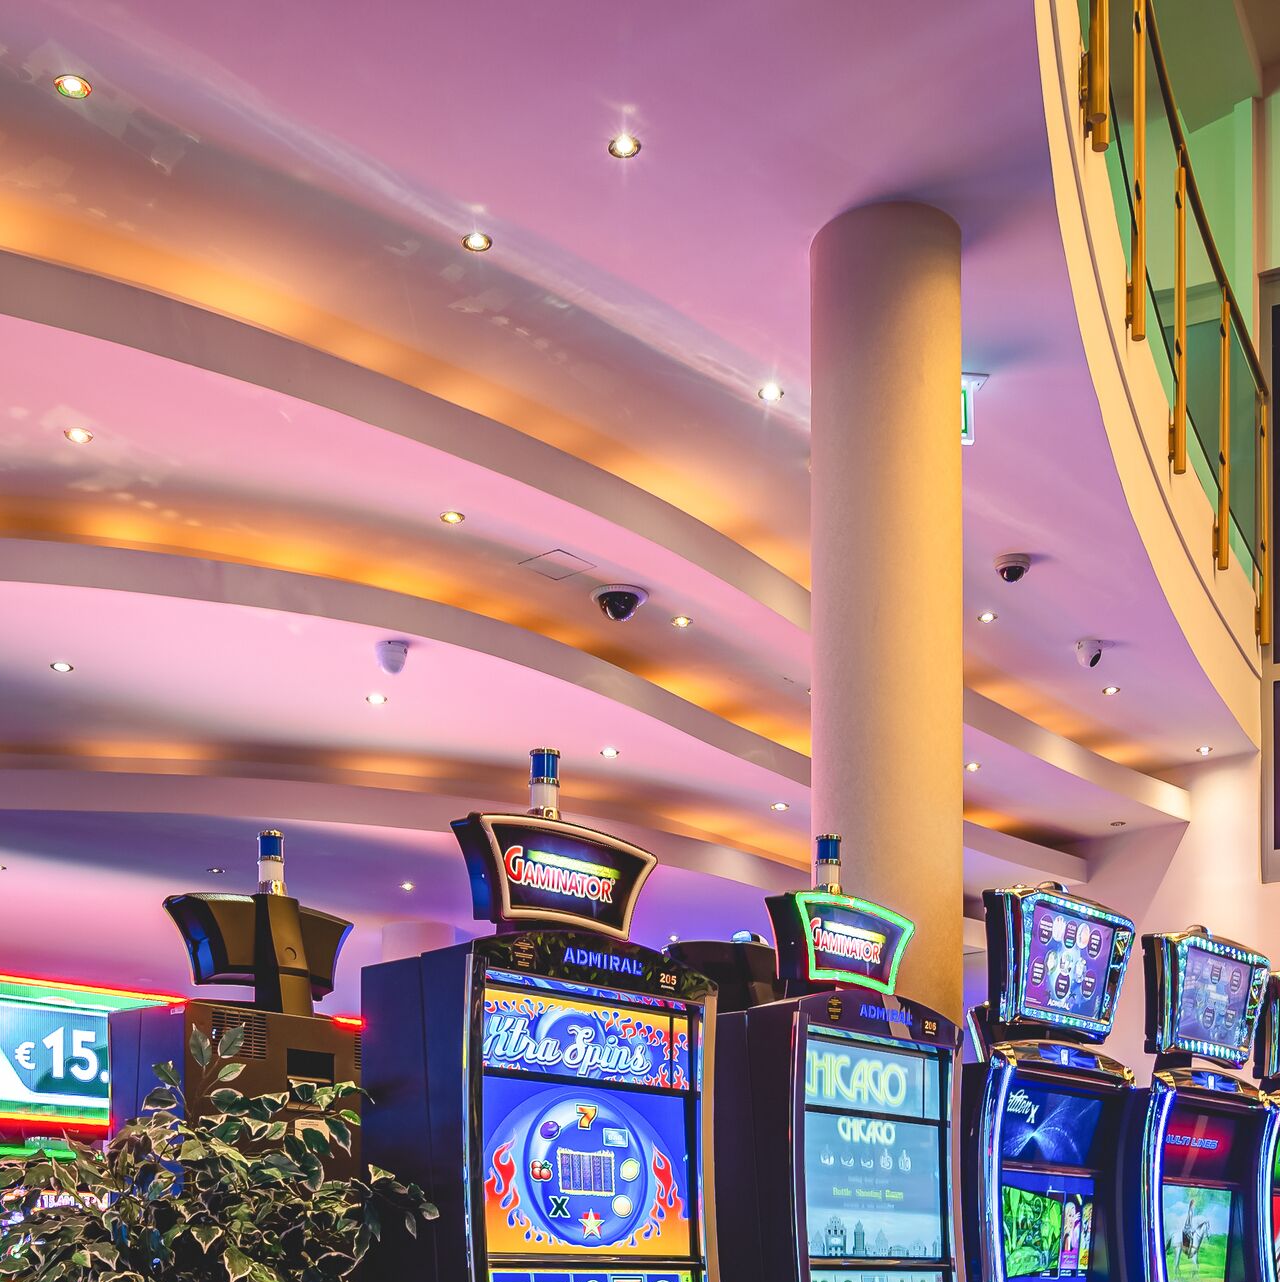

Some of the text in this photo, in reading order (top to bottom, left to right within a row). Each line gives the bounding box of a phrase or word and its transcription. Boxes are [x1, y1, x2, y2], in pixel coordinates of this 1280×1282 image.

[504, 846, 614, 903] GAMINATOR
[810, 917, 881, 964] GAMINATOR
[563, 947, 642, 976] ADMIRAL
[659, 972, 677, 986] 205
[859, 1003, 913, 1027] ADMIRAL
[924, 1019, 937, 1031] 206
[483, 1014, 651, 1077] Xtra Spins
[576, 1104, 599, 1131] 7
[548, 1195, 570, 1219] X
